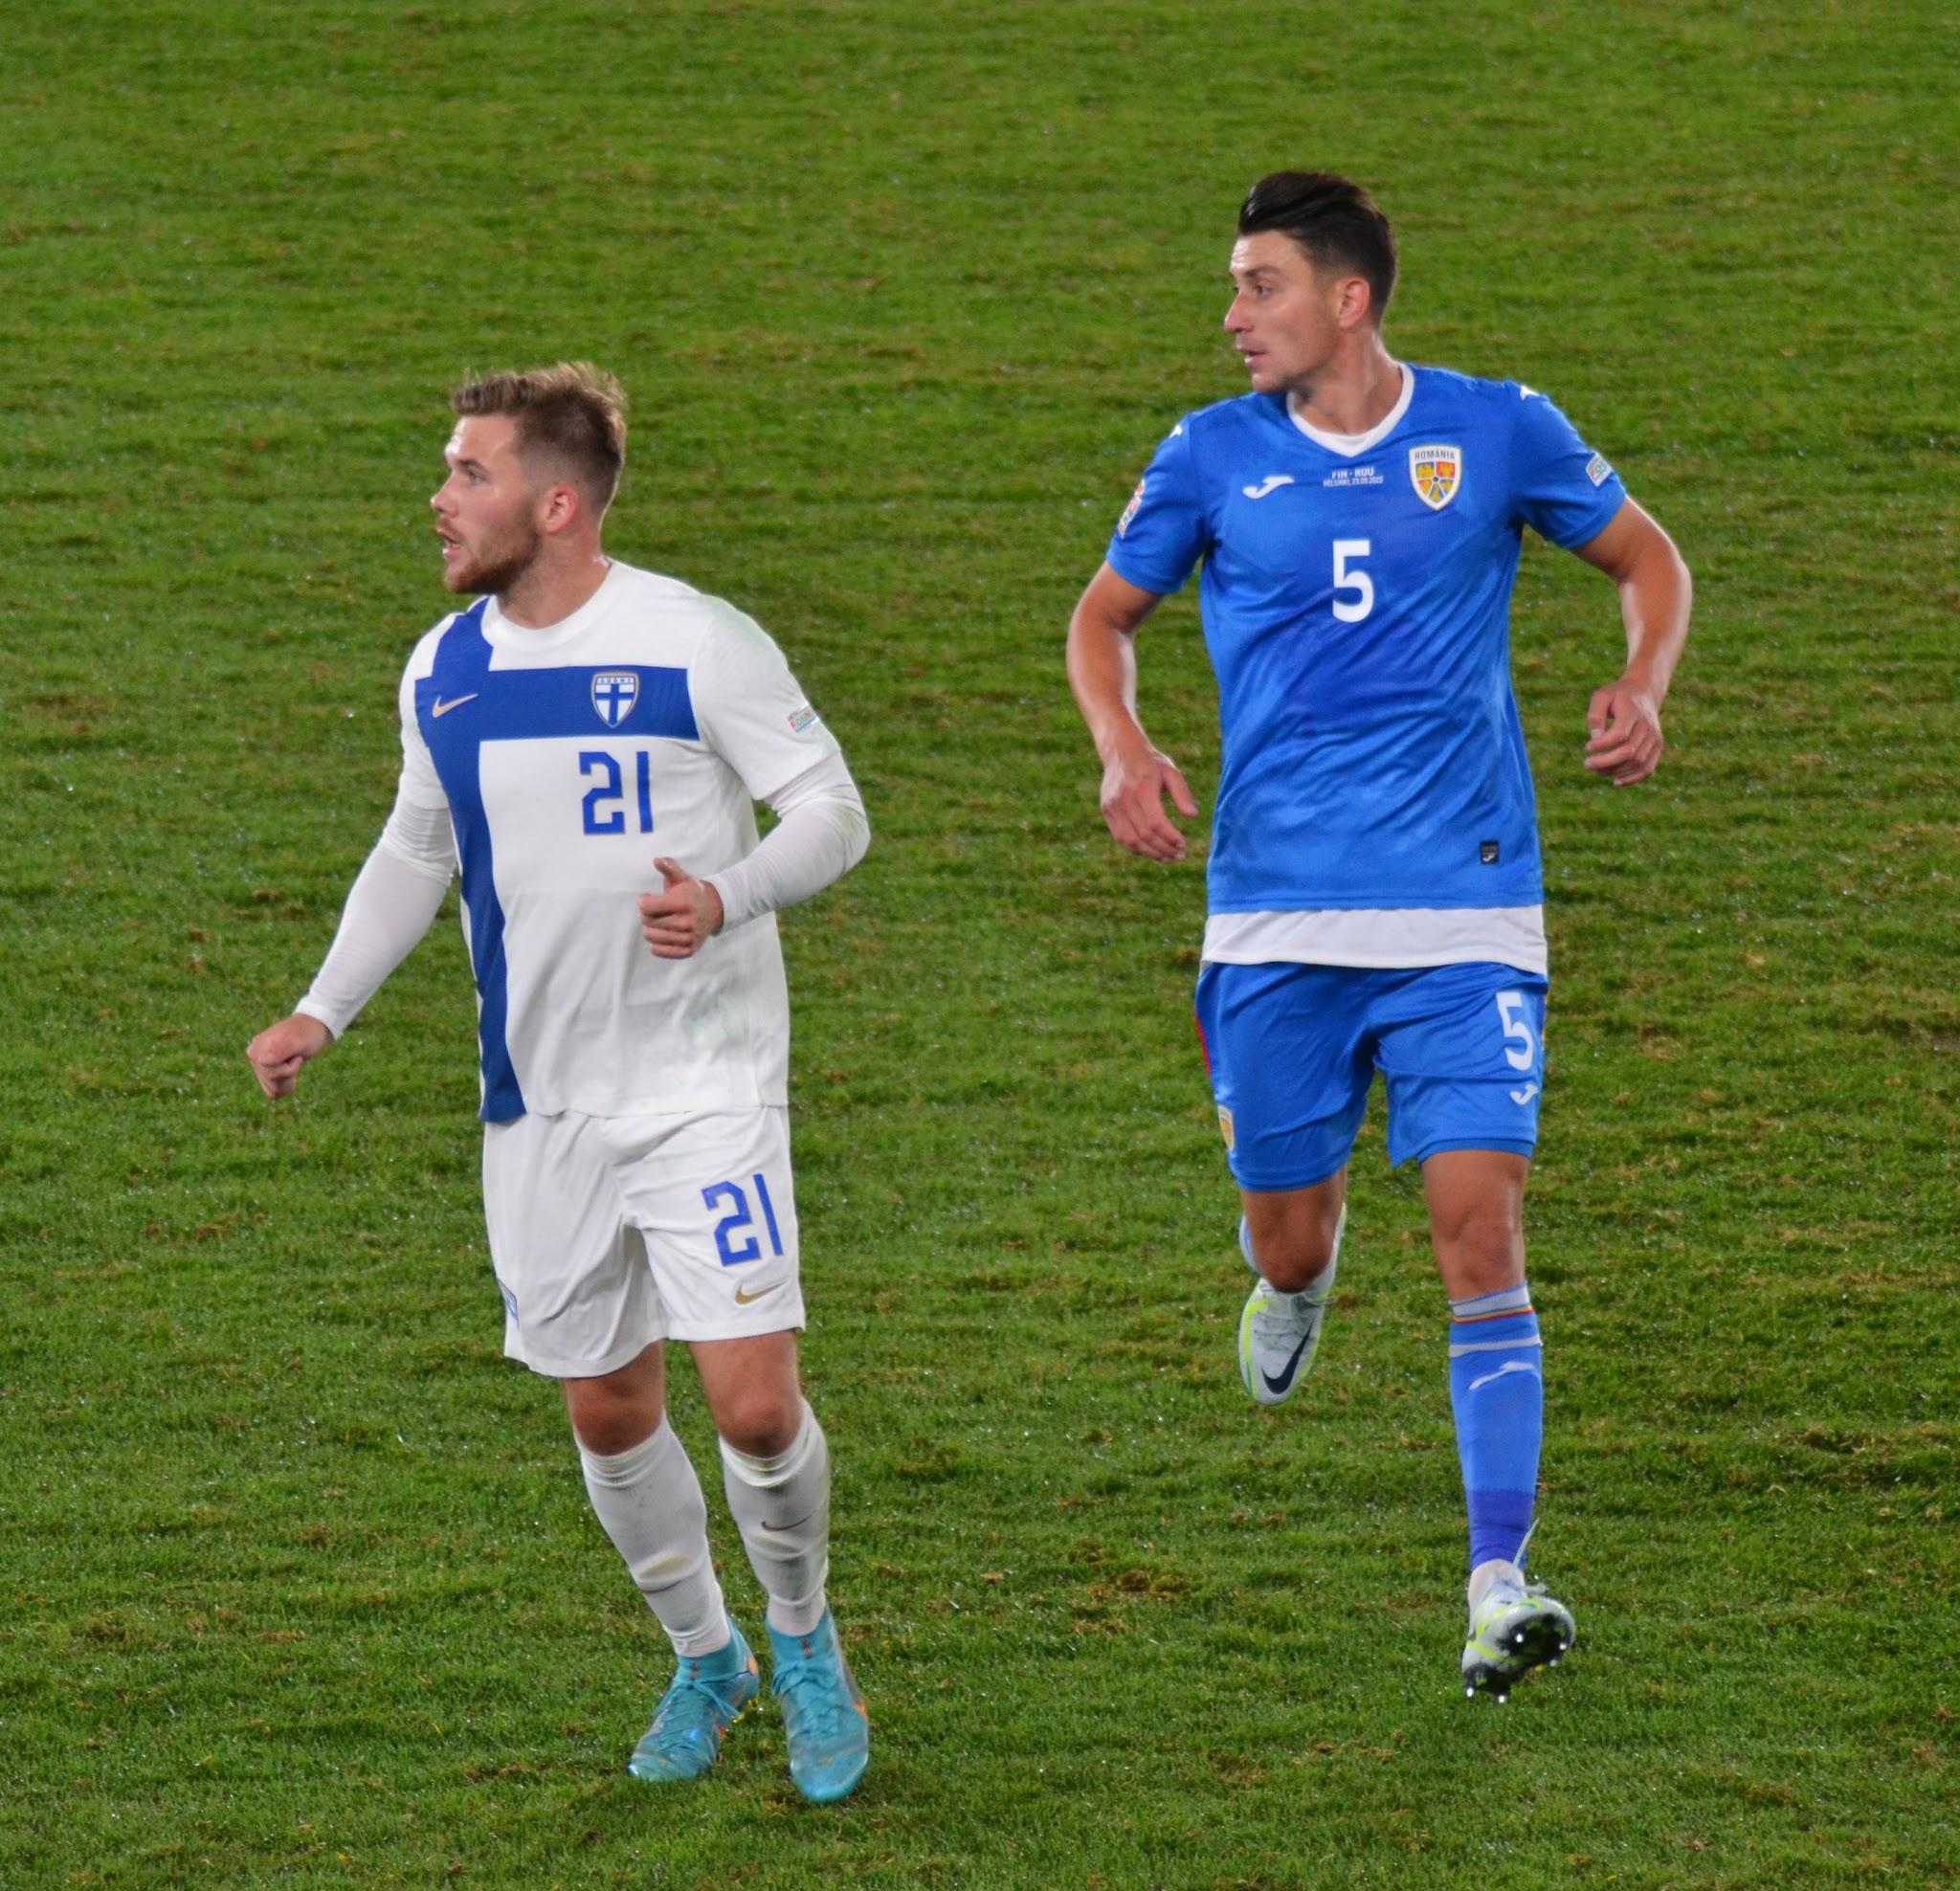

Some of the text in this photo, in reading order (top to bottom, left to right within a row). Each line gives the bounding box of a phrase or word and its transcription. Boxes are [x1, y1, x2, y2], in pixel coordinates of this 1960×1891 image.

[1331, 470, 1348, 479] FIN
[1354, 466, 1374, 478] ROU
[1332, 540, 1374, 623] 5
[578, 750, 655, 835] 21
[1496, 991, 1533, 1071] 5
[701, 1173, 784, 1267] 21
